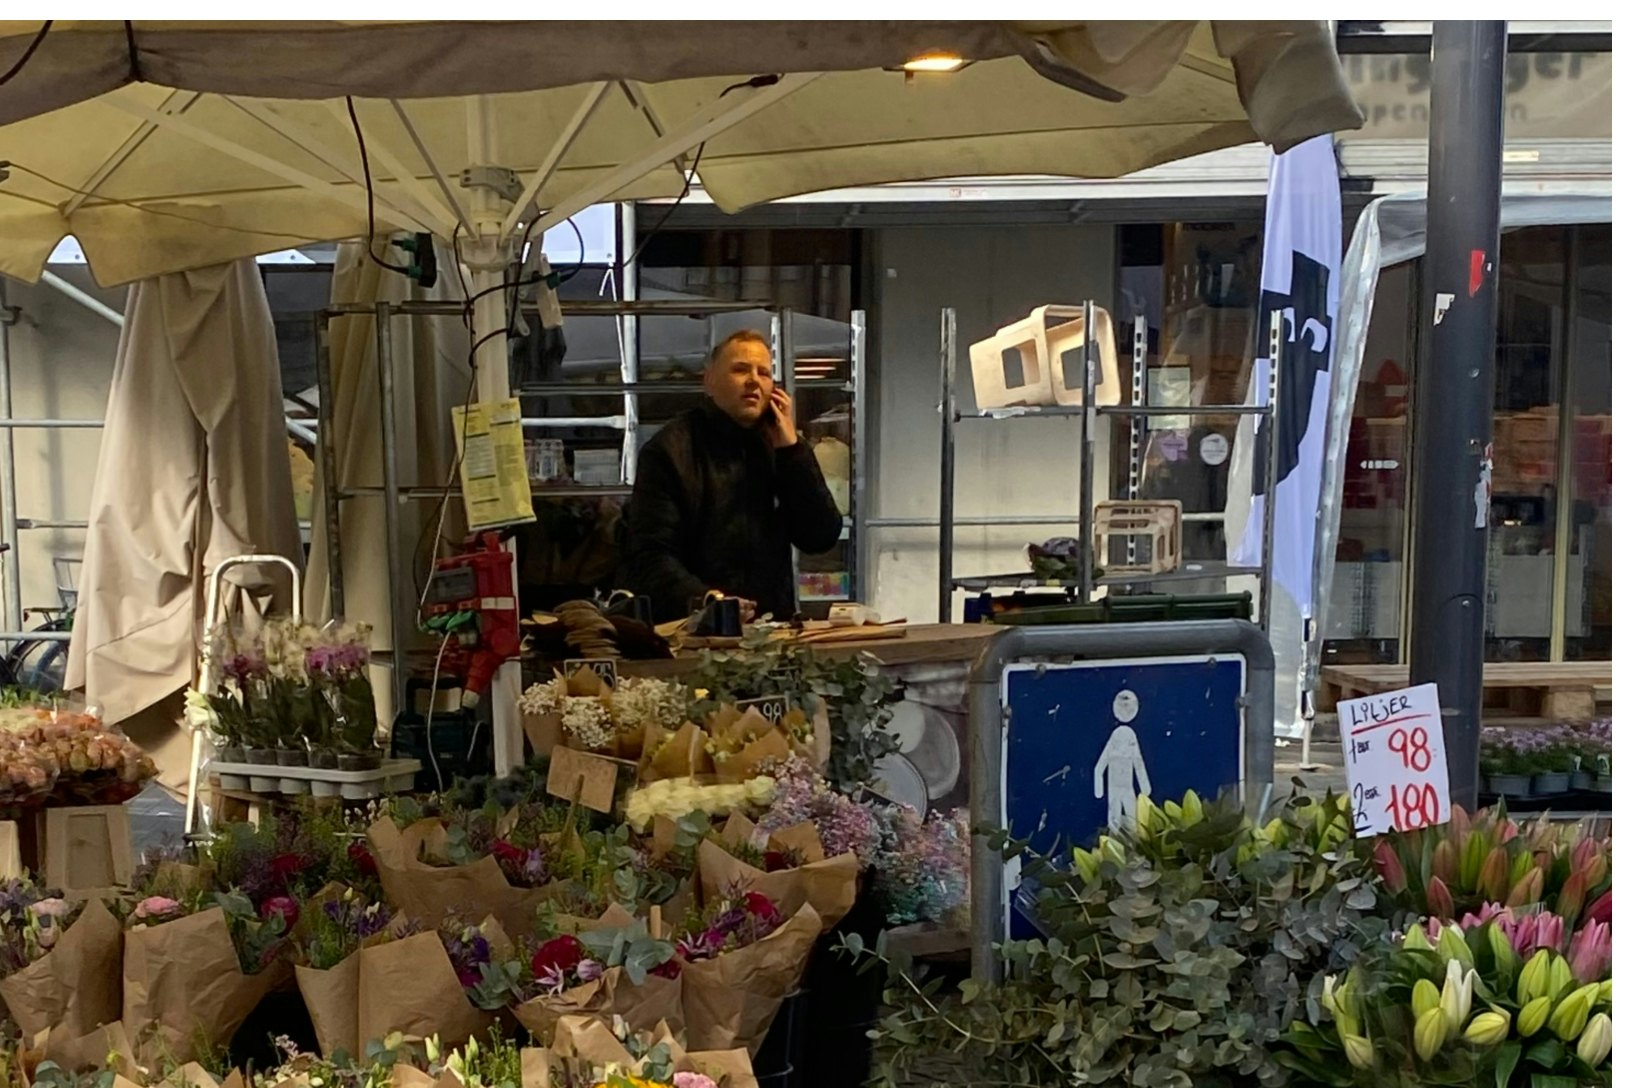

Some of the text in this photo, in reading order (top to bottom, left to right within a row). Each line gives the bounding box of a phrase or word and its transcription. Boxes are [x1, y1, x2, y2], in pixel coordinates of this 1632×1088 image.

[1351, 695, 1412, 725] LILJER
[1388, 727, 1432, 772] 98
[1385, 783, 1439, 832] 180
